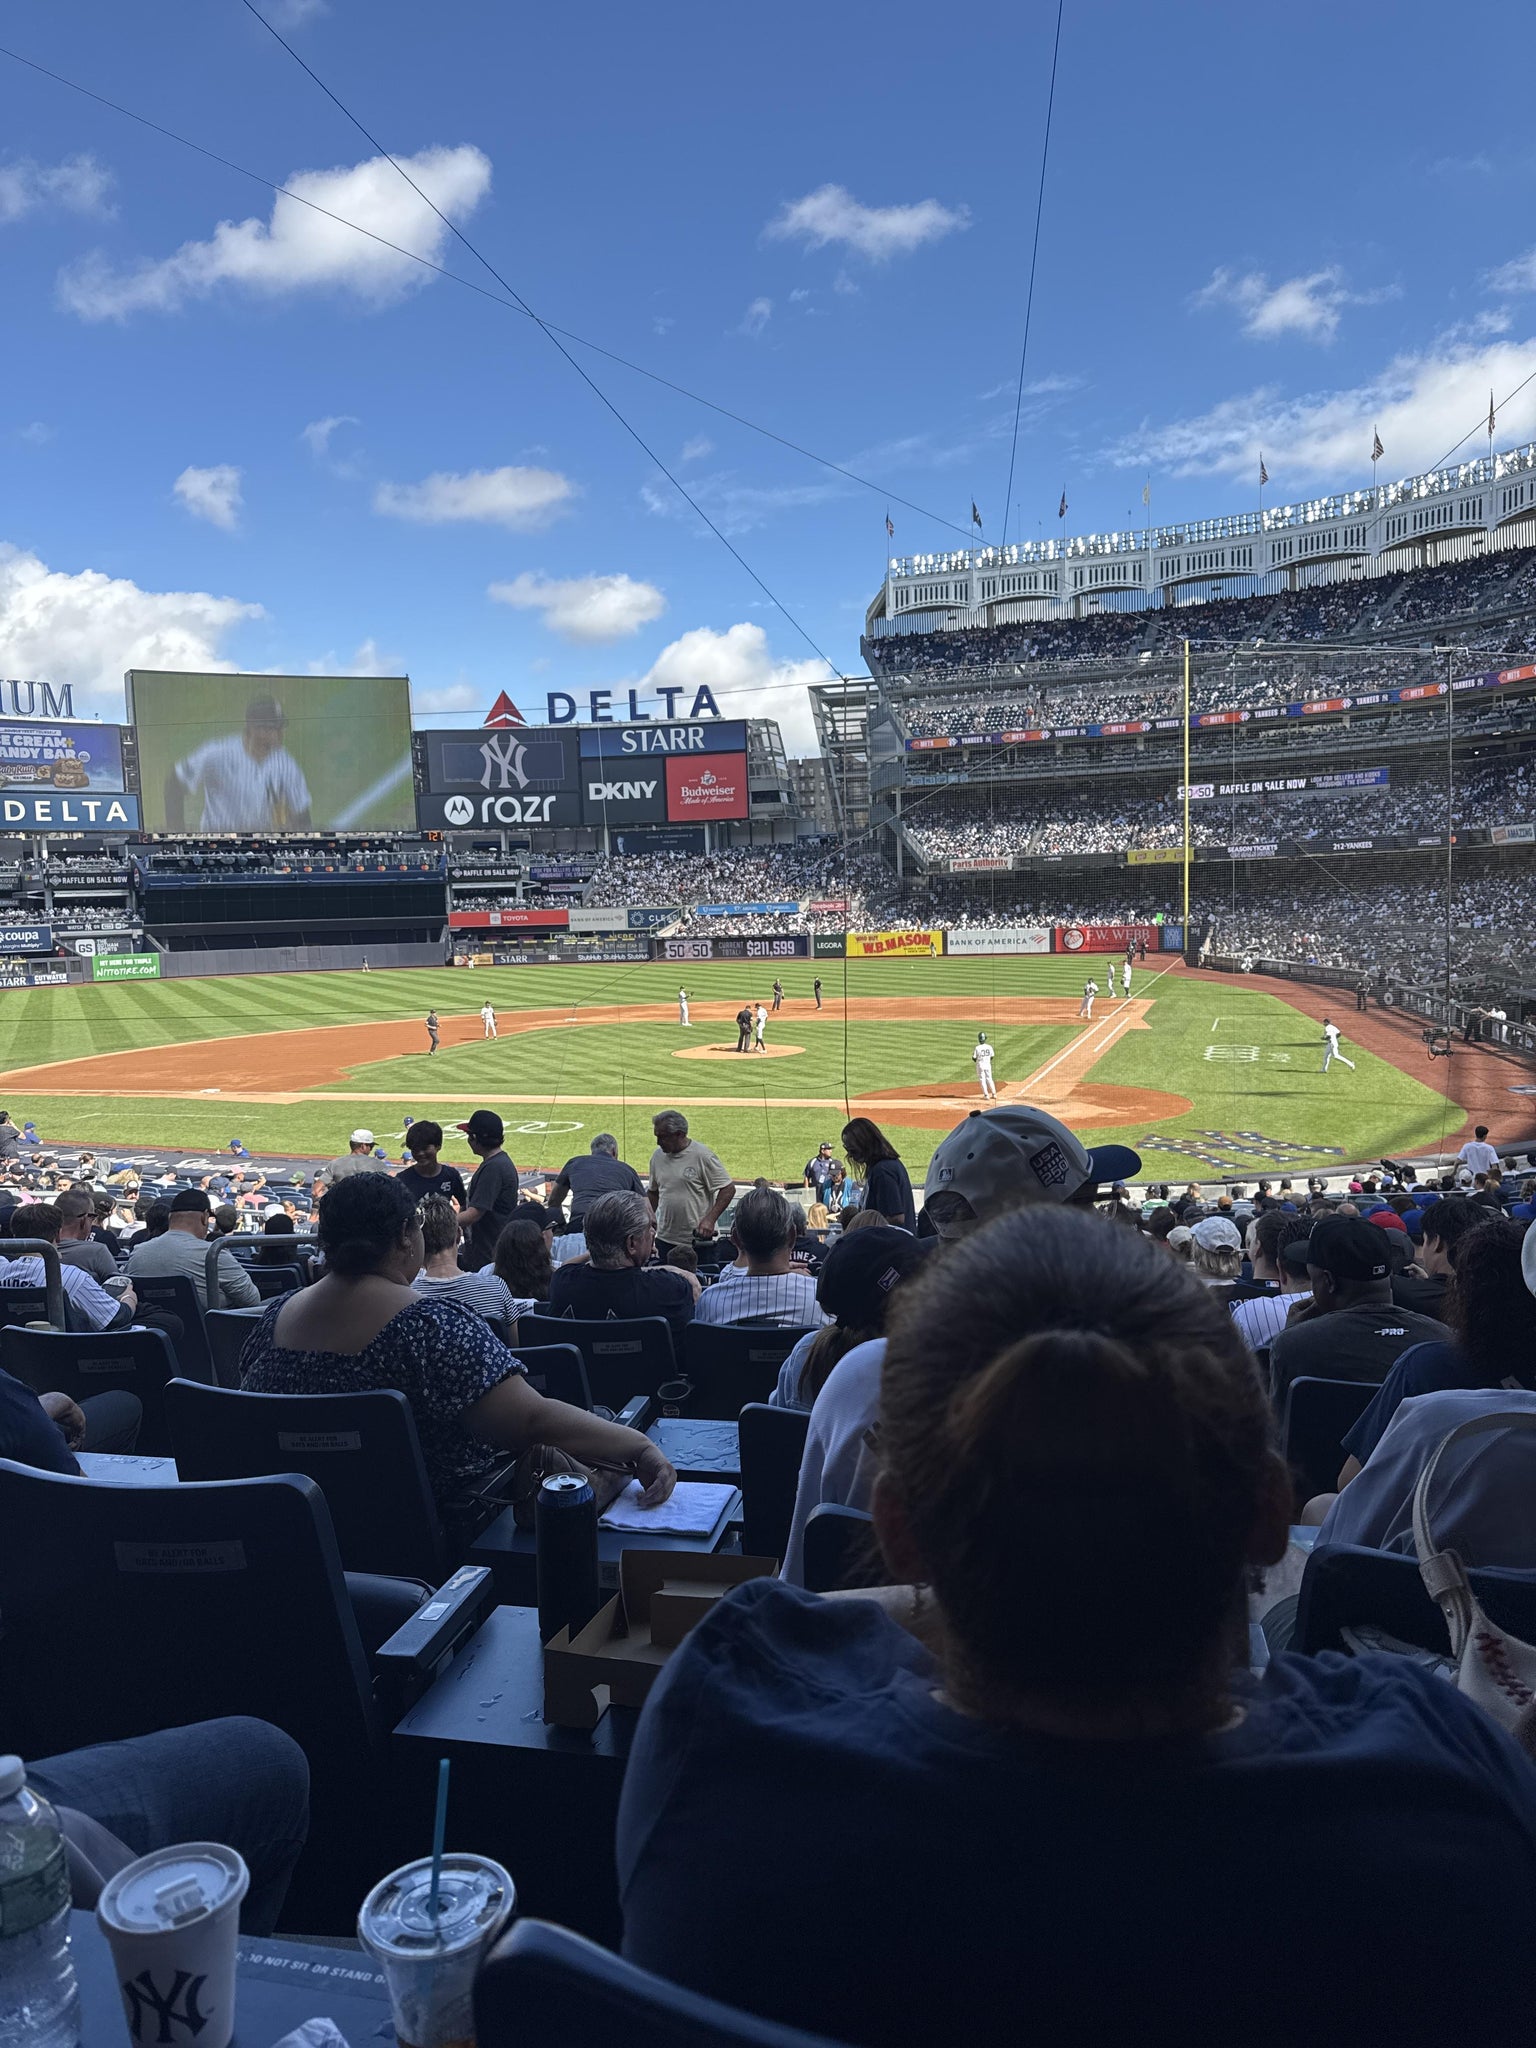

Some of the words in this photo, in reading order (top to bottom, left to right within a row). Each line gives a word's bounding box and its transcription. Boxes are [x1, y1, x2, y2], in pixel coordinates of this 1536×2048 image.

[1453, 679, 1475, 690] YANKEES
[547, 684, 721, 724] DELTA
[1356, 695, 1379, 705] YANKEES
[1255, 709, 1278, 718] YANKEES
[1156, 720, 1179, 728] YANKEES
[1055, 729, 1077, 737] YANKEES
[0, 735, 11, 745] E
[622, 727, 705, 753] STARR
[43, 749, 76, 759] BAR
[480, 734, 530, 790] NY
[588, 781, 657, 800] DKNY
[681, 785, 735, 796] Budweiser
[1198, 787, 1211, 797] 50
[1220, 784, 1249, 795] RAFFLE
[1252, 782, 1263, 792] ON
[1265, 780, 1285, 791] SALE
[1286, 779, 1306, 789] NOW
[4, 800, 128, 822] DELTA
[482, 795, 556, 823] razr
[1227, 845, 1253, 853] SEASON
[1332, 841, 1373, 850] 212-YANKEES
[952, 860, 971, 868] Parts
[973, 858, 1008, 868] Authority
[62, 877, 85, 885] RAFFLE
[86, 876, 95, 884] ON
[96, 876, 111, 884] SALE
[113, 875, 128, 883] NOW
[5, 931, 39, 942] coupa
[1086, 929, 1109, 940] F.W.
[1112, 928, 1151, 939] WEBB
[987, 937, 1027, 945] AMERICA
[79, 944, 92, 952] GS
[669, 944, 684, 957] 50
[692, 943, 707, 957] 50
[747, 940, 795, 957] $211,599
[500, 955, 528, 963] STARR
[34, 973, 67, 981] CUTWATER
[96, 966, 157, 977] NITTOTIRE.COM
[980, 1049, 990, 1057] 39
[1033, 1146, 1059, 1168] USA
[1040, 1159, 1068, 1185] 250
[440, 1181, 451, 1192] 45
[1381, 1327, 1405, 1336] PRO
[264, 1956, 291, 1968] NOT
[290, 1961, 311, 1971] SIT
[312, 1964, 330, 1975] OR
[330, 1967, 372, 1982] STAND
[123, 1969, 214, 2043] NY
